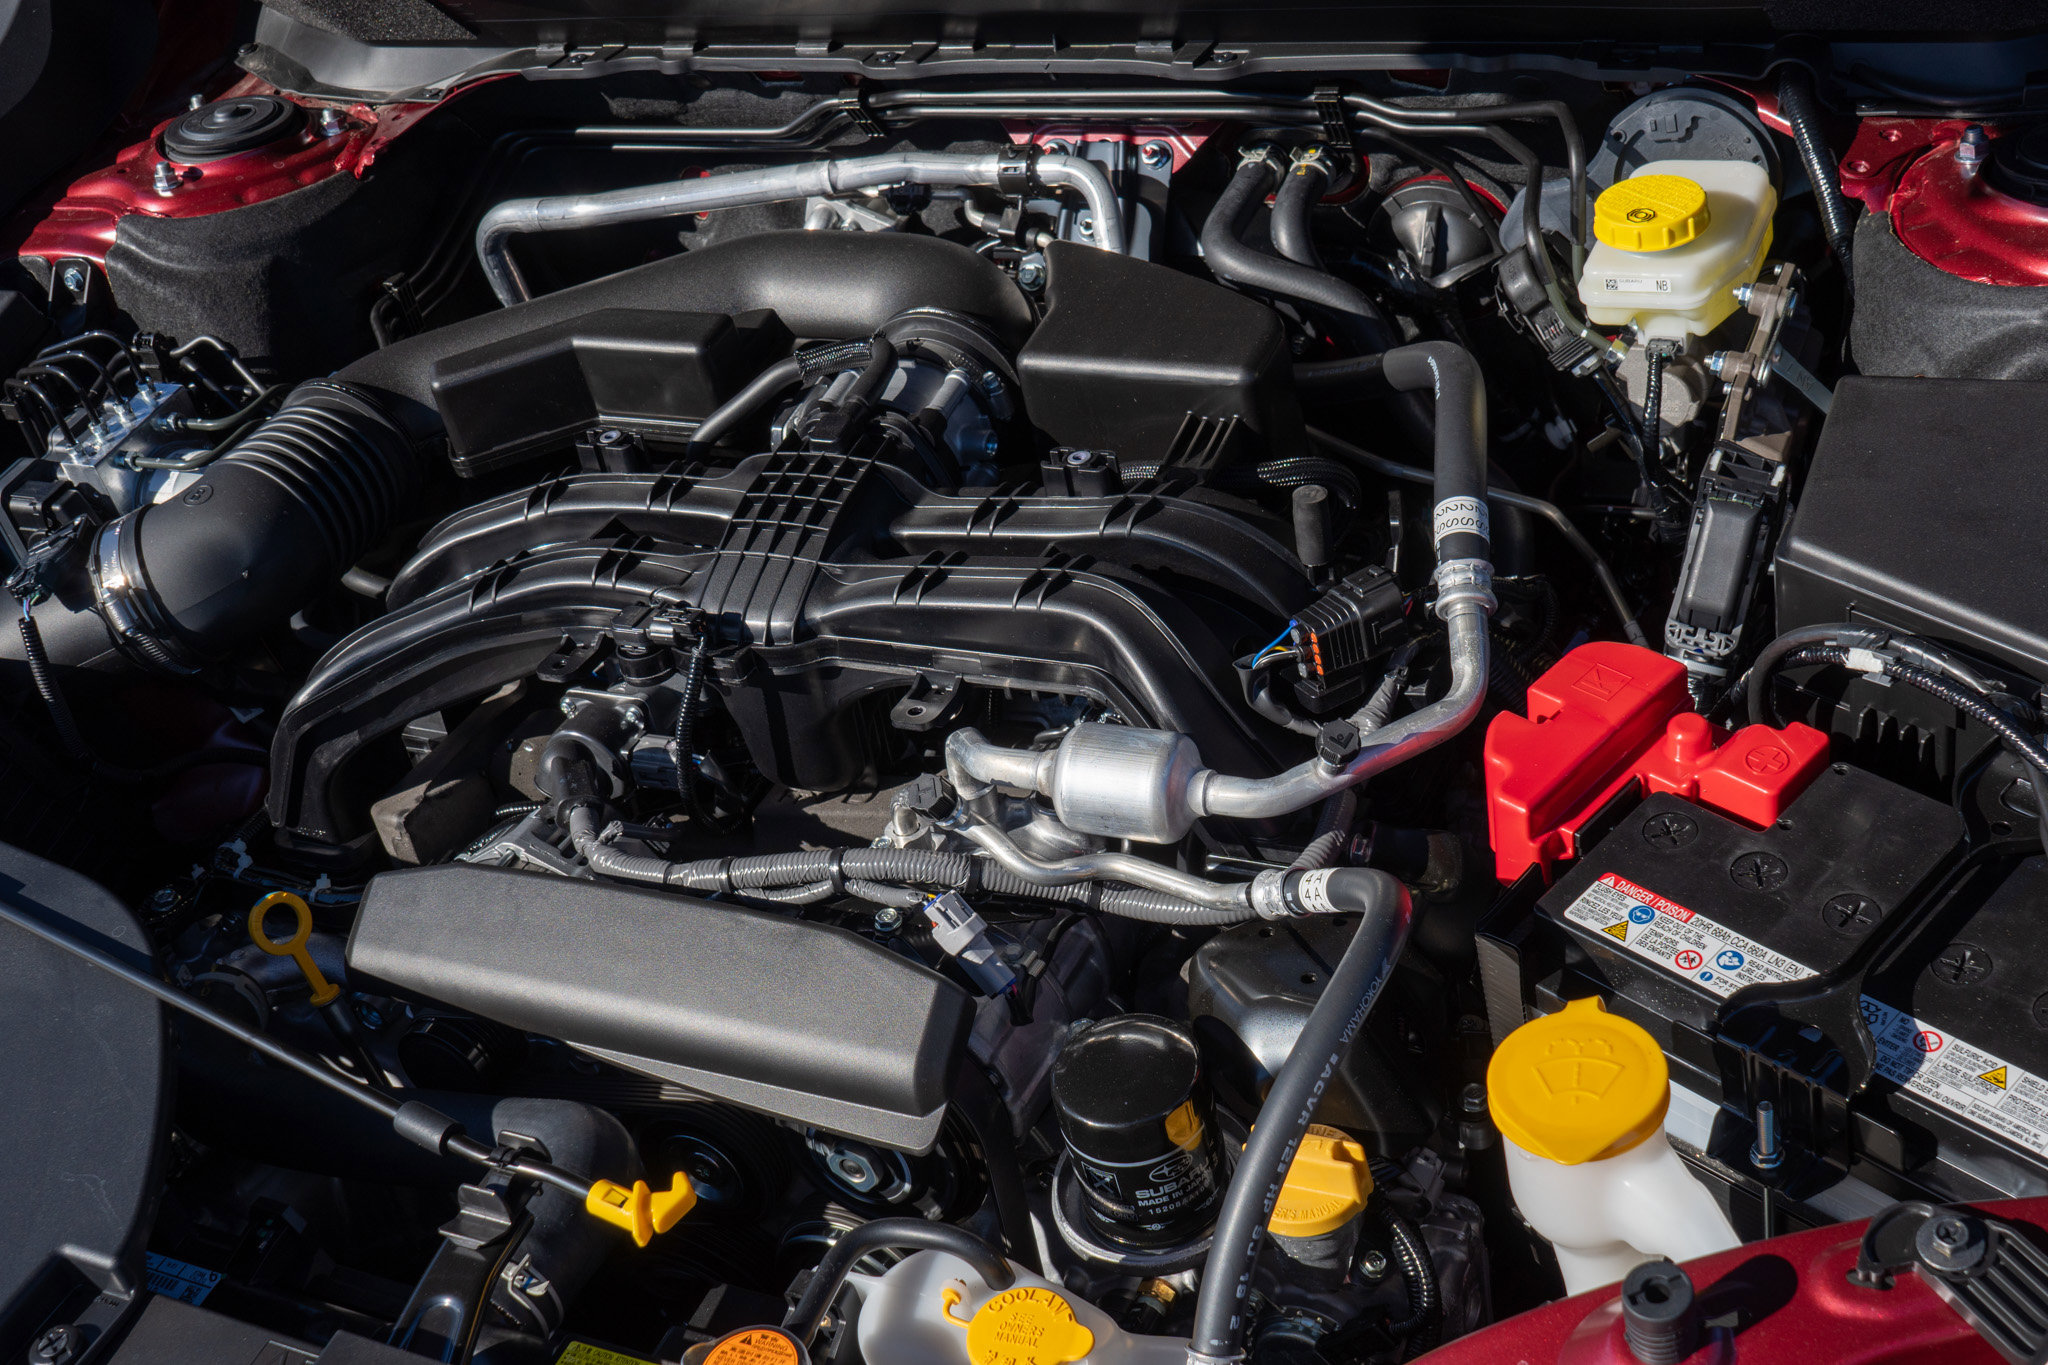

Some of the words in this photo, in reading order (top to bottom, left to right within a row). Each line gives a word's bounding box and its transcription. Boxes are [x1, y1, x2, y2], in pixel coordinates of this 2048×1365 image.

[1656, 280, 1668, 291] NB
[1595, 883, 1614, 894] FLUSH
[1611, 891, 1627, 902] EYES
[1615, 881, 1654, 904] DANGER
[1656, 900, 1691, 923] POISON
[1580, 897, 1599, 909] RINCEZ
[1598, 906, 1611, 915] LES
[1610, 911, 1624, 921] YEUX
[1641, 933, 1651, 941] DE
[1649, 928, 1664, 939] TENIR
[1653, 921, 1671, 932] REACH
[1679, 934, 1707, 950] CHILDREN
[1659, 916, 1674, 925] KEEP
[1673, 922, 1685, 930] OUT
[1693, 931, 1705, 941] THE
[1635, 939, 1649, 948] DES
[1647, 944, 1672, 960] ENFANTS
[1690, 917, 1714, 932] 20HR
[1711, 927, 1731, 941] 68Ah
[1730, 936, 1749, 950] CCA
[1747, 945, 1768, 958] 660A
[1767, 955, 1786, 968] LN3
[1782, 962, 1804, 978] (EN)
[1741, 966, 1756, 976] LIRE
[1754, 972, 1767, 981] LES
[1748, 959, 1764, 970] READ
[1715, 976, 1729, 985] FOR
[1339, 976, 1382, 1043] YOKOHAMA
[1952, 1044, 1983, 1062] SULFURIC
[1982, 1058, 1998, 1069] ACID
[1879, 1055, 1891, 1064] DO
[1890, 1061, 1904, 1069] NOT
[1902, 1067, 1914, 1075] TIP
[1913, 1072, 1924, 1080] OR
[1923, 1077, 1941, 1089] OPEN
[1936, 1061, 1962, 1076] L'ACIDE
[1960, 1072, 2001, 1094] SULFURIQUE
[1883, 1066, 1897, 1076] PAS
[1894, 1072, 1932, 1093] RENVERSER
[1931, 1091, 1942, 1099] OU
[1941, 1096, 1967, 1111] OUVRIR
[2022, 1077, 2045, 1091] SHIELD
[2007, 1094, 2042, 1115] PROTÉGEZ
[1135, 1156, 1208, 1199] SUBARU
[1138, 1195, 1170, 1207] MADE
[1172, 1190, 1184, 1199] IN
[1185, 1167, 1213, 1192] JAPAN
[1263, 1183, 1278, 1213] HP
[1300, 1199, 1343, 1219] MANUAL
[1010, 1311, 1036, 1325] SEE
[1230, 1315, 1241, 1330] 2
[755, 1338, 789, 1352] WARNING
[994, 1330, 1039, 1349] MANUAL
